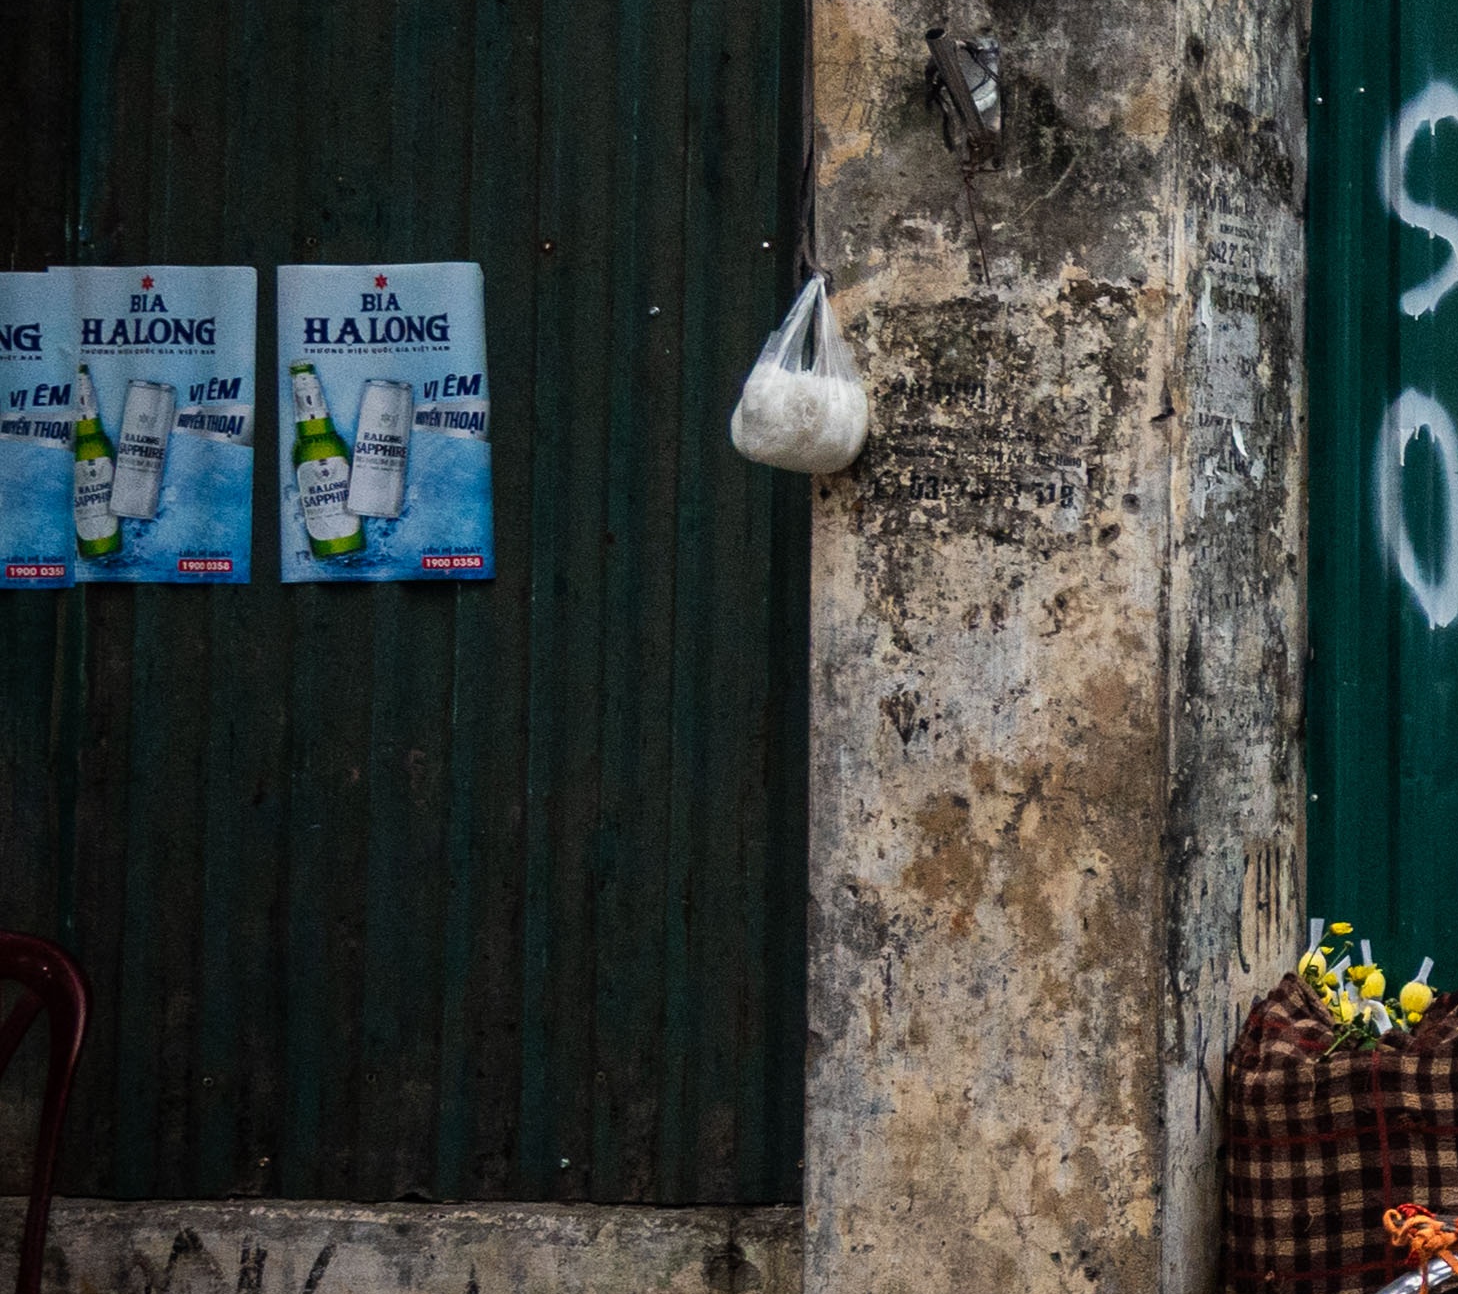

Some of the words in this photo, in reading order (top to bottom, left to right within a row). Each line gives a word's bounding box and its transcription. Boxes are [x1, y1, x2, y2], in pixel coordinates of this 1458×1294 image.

[130, 294, 168, 313] BIA
[361, 293, 400, 313] BIA
[443, 374, 482, 397] ÊM
[425, 557, 451, 568] 1900
